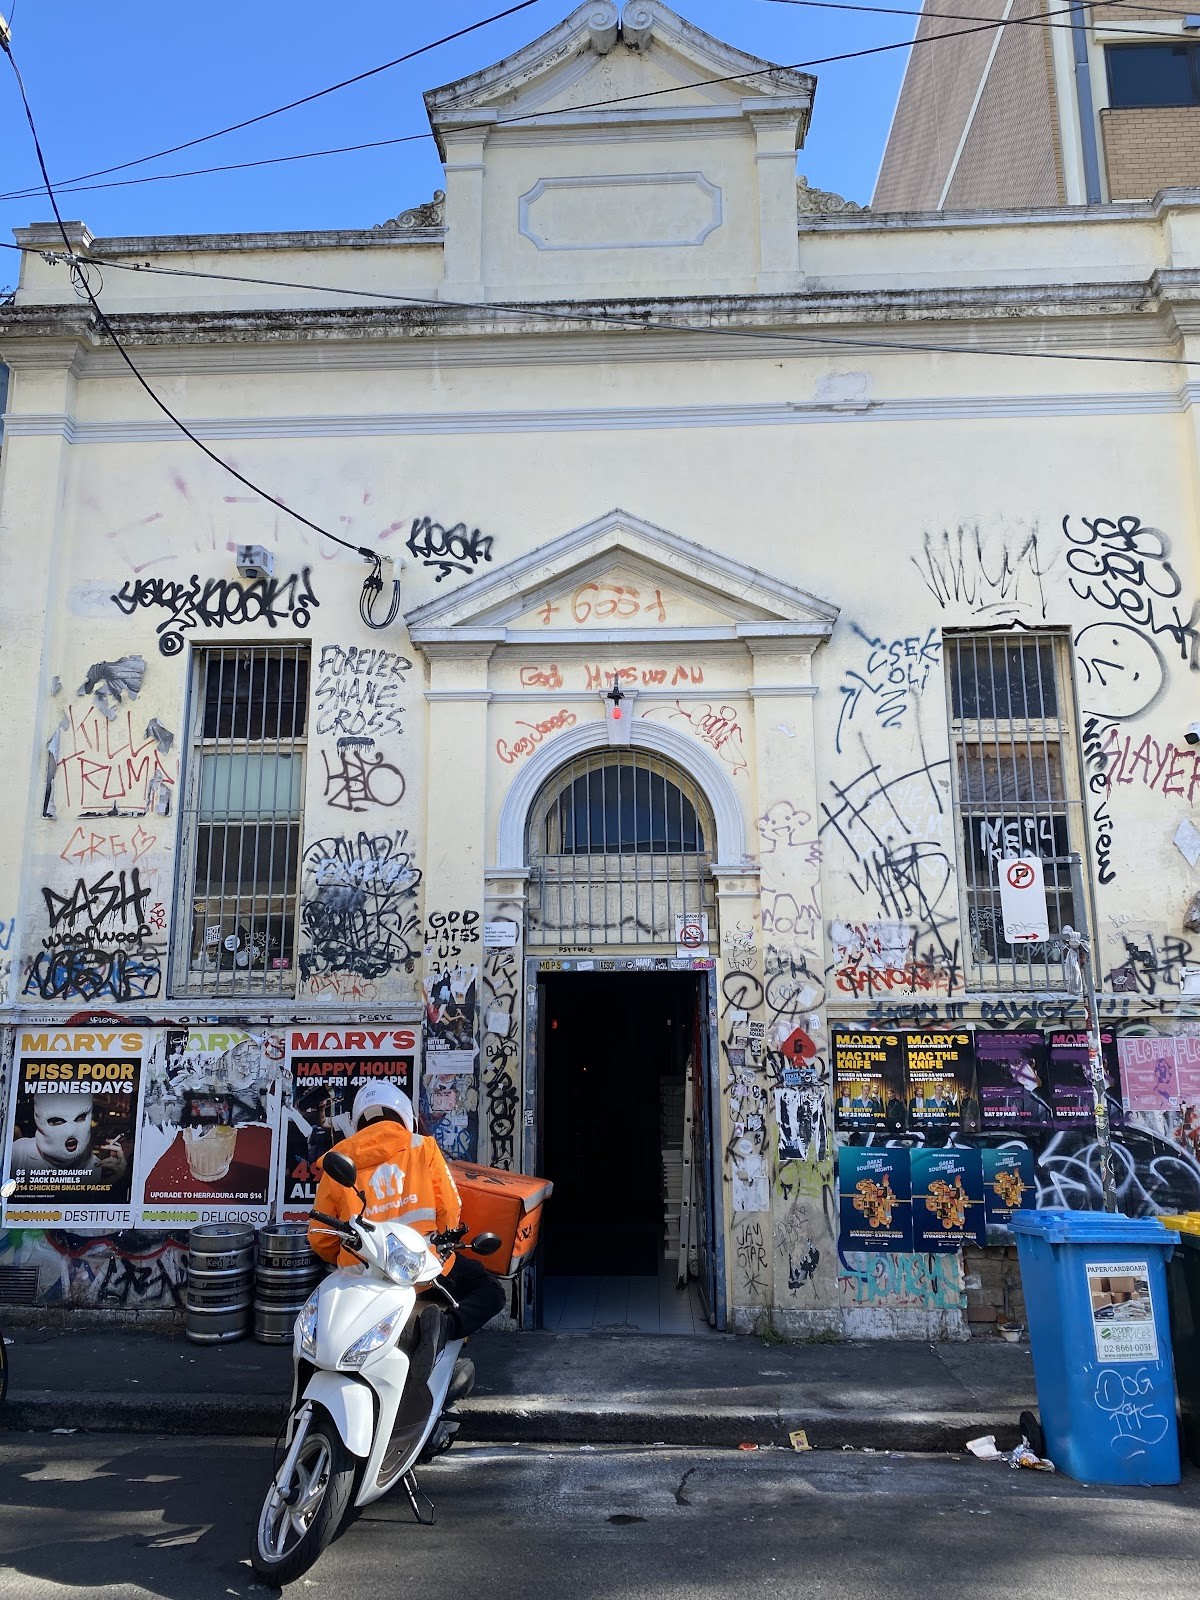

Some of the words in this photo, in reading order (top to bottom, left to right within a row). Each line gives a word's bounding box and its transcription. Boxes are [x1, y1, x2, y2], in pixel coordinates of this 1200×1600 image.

[320, 644, 413, 683] FOREVER
[315, 677, 399, 712] SHANE
[68, 705, 155, 760] KILL
[41, 867, 151, 928] DASH
[429, 910, 479, 929] GOD
[425, 927, 480, 944] HATES
[438, 946, 461, 960] US
[20, 1032, 143, 1052] MARY'S
[292, 1031, 415, 1051] MARY'S
[835, 1034, 898, 1046] MARY'S
[907, 1034, 969, 1045] MARY'S
[1052, 1033, 1113, 1044] MARS
[837, 1051, 862, 1061] MAC
[862, 1052, 886, 1061] THE
[908, 1051, 934, 1061] MAC
[934, 1052, 958, 1061] THE
[297, 1062, 356, 1076] HAPPY
[360, 1062, 407, 1076] HOUR
[837, 1060, 871, 1069] KNIFE
[909, 1060, 943, 1069] KNIFE
[26, 1064, 73, 1080] PISS
[77, 1064, 134, 1080] POOR
[25, 1081, 133, 1094] WEDNESDAYS
[297, 1076, 347, 1087] MON-FRI
[150, 1191, 182, 1199] UPGRADE
[365, 1194, 418, 1217] Menulog
[64, 1210, 130, 1222] DESTITUTE
[201, 1211, 268, 1223] DELICIOSO
[281, 1257, 312, 1268] Kegstar
[1087, 1265, 1147, 1273] PAPER/CARDBOARD
[1104, 1345, 1114, 1353] 02
[1116, 1344, 1133, 1352] 8661
[1134, 1344, 1151, 1352] 0031
